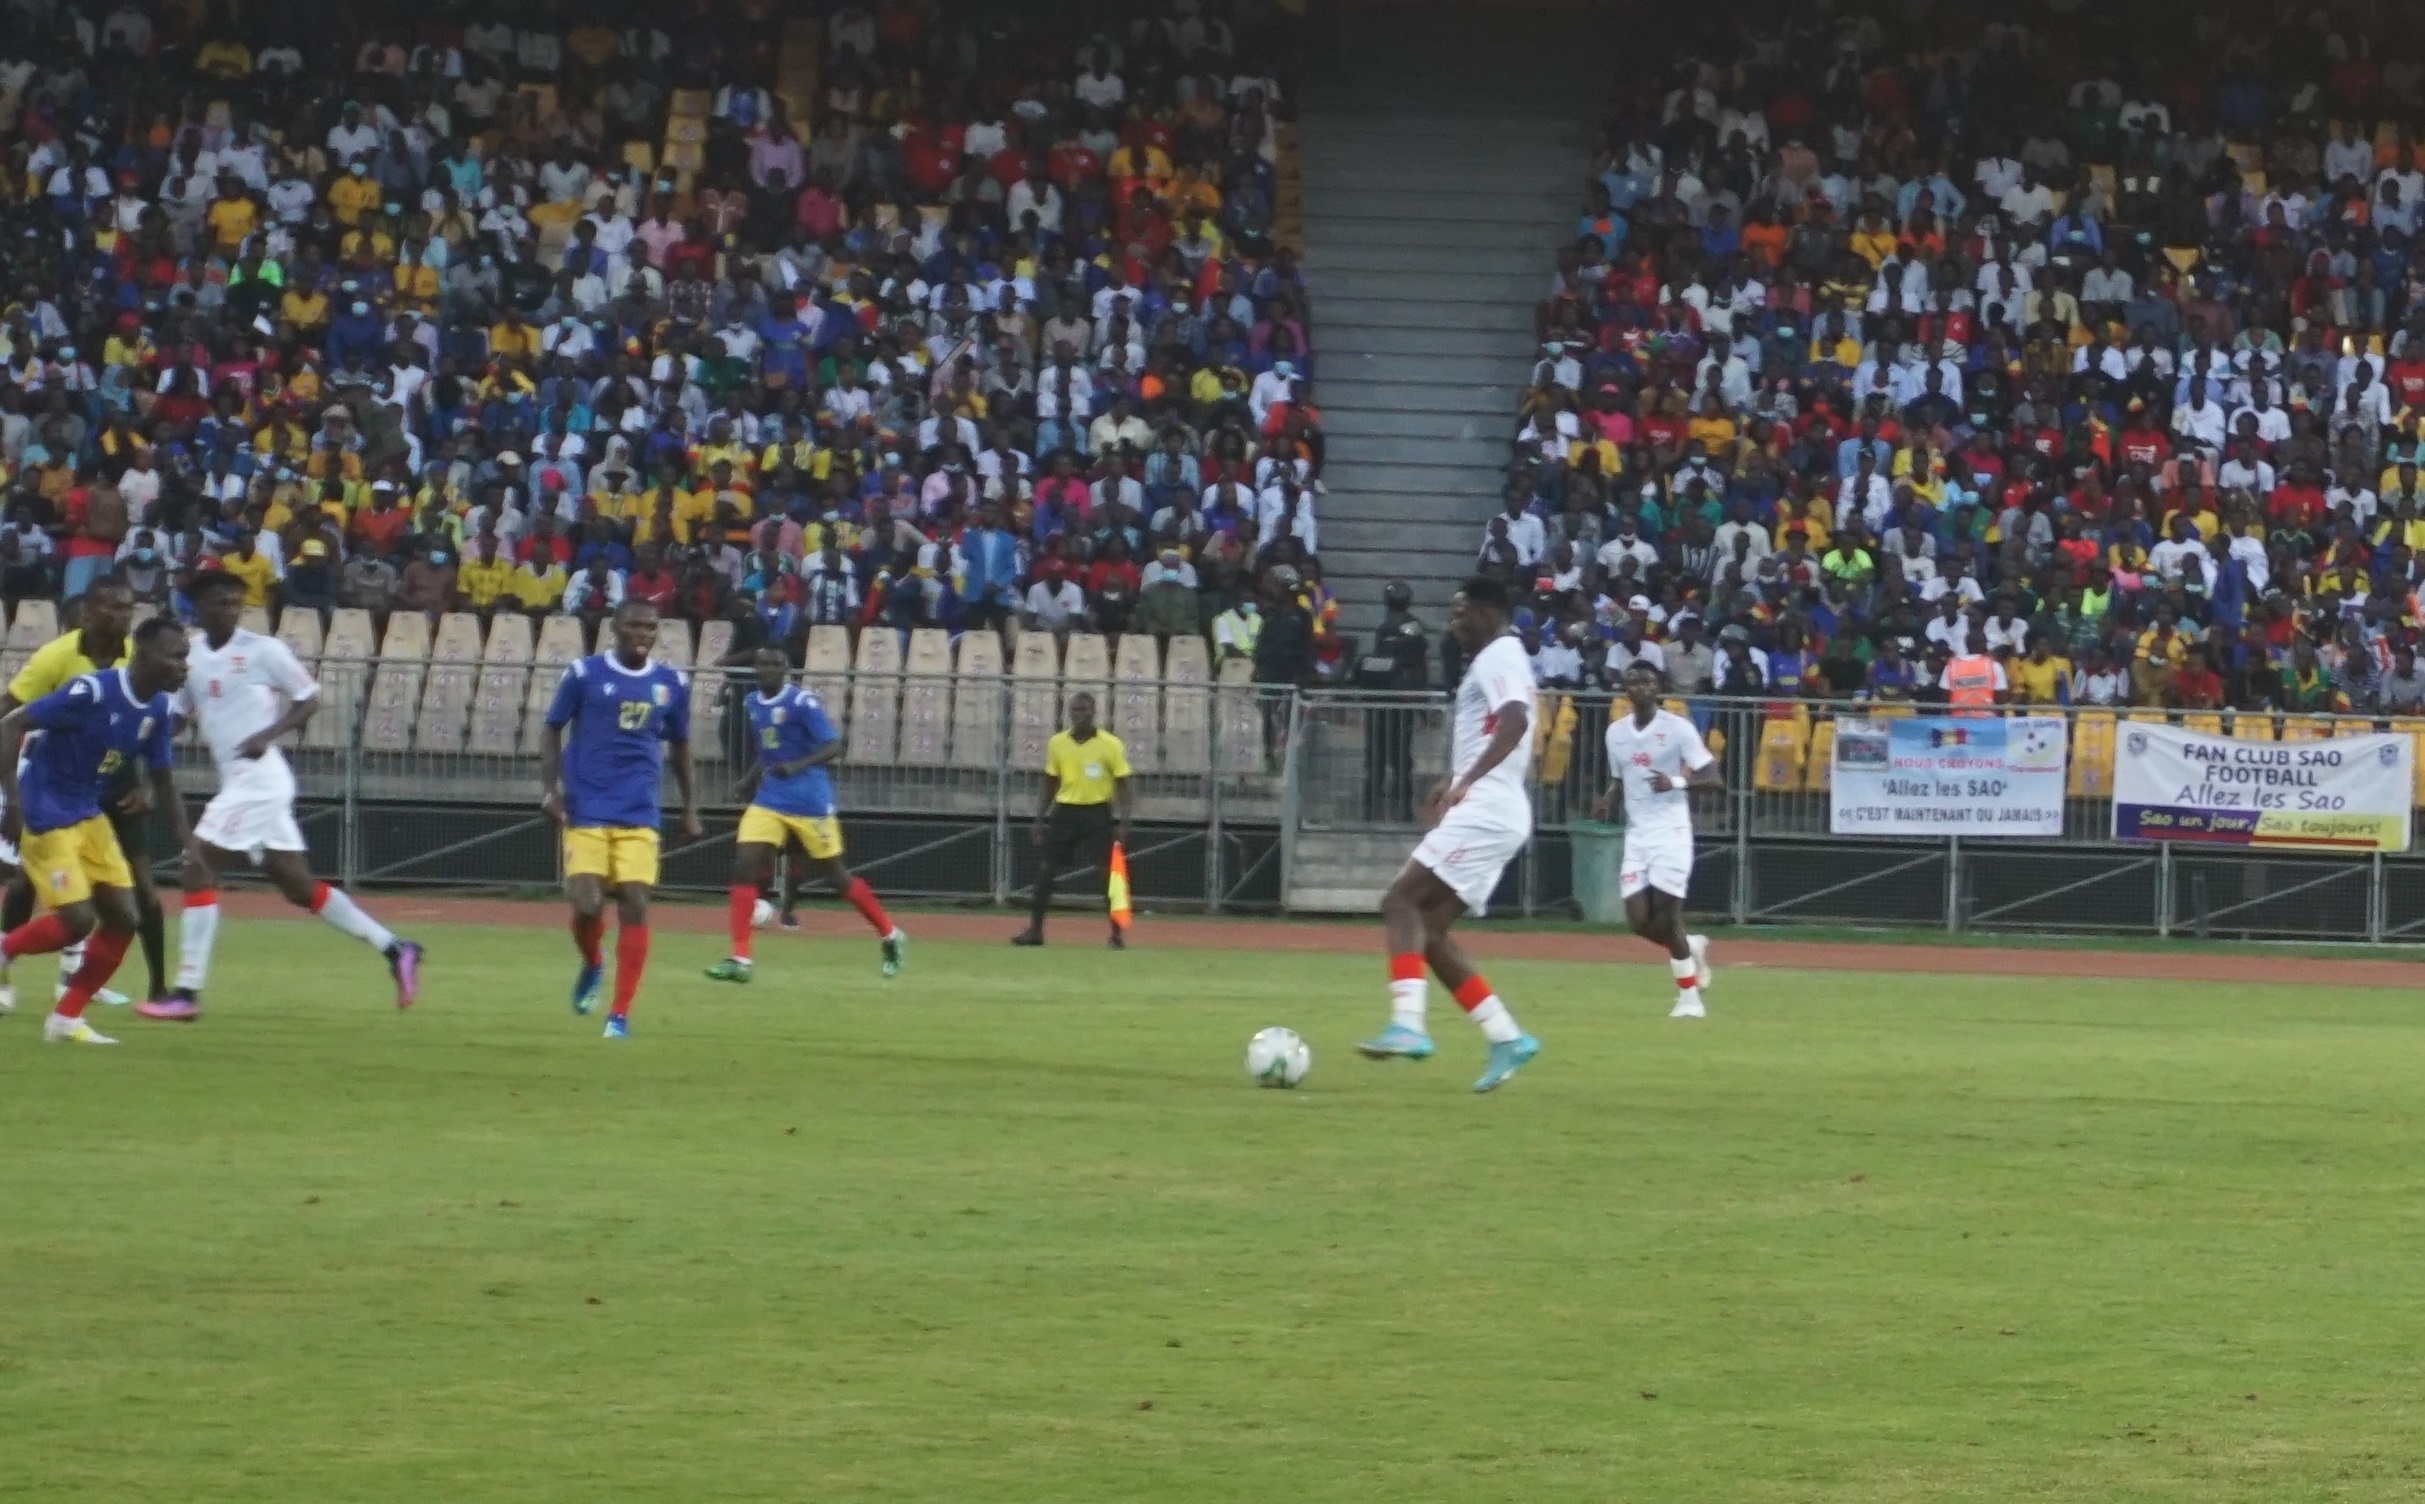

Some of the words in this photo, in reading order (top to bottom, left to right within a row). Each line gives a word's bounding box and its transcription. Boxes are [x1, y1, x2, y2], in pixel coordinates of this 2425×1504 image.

[619, 700, 652, 730] 27
[2183, 743, 2226, 762] FAN
[2235, 748, 2290, 765] CLUB
[2298, 750, 2341, 767] SAO
[2206, 765, 2318, 786] FOOTBALL
[1935, 780, 1960, 797] les
[2175, 783, 2241, 807] Allez
[2253, 787, 2286, 809] les
[2299, 790, 2345, 811] Sao
[1895, 807, 1971, 822] MAINTENANT
[1977, 807, 1993, 822] OU
[2140, 809, 2174, 827] Sao
[2179, 816, 2203, 828] un
[2261, 817, 2293, 832] Sao
